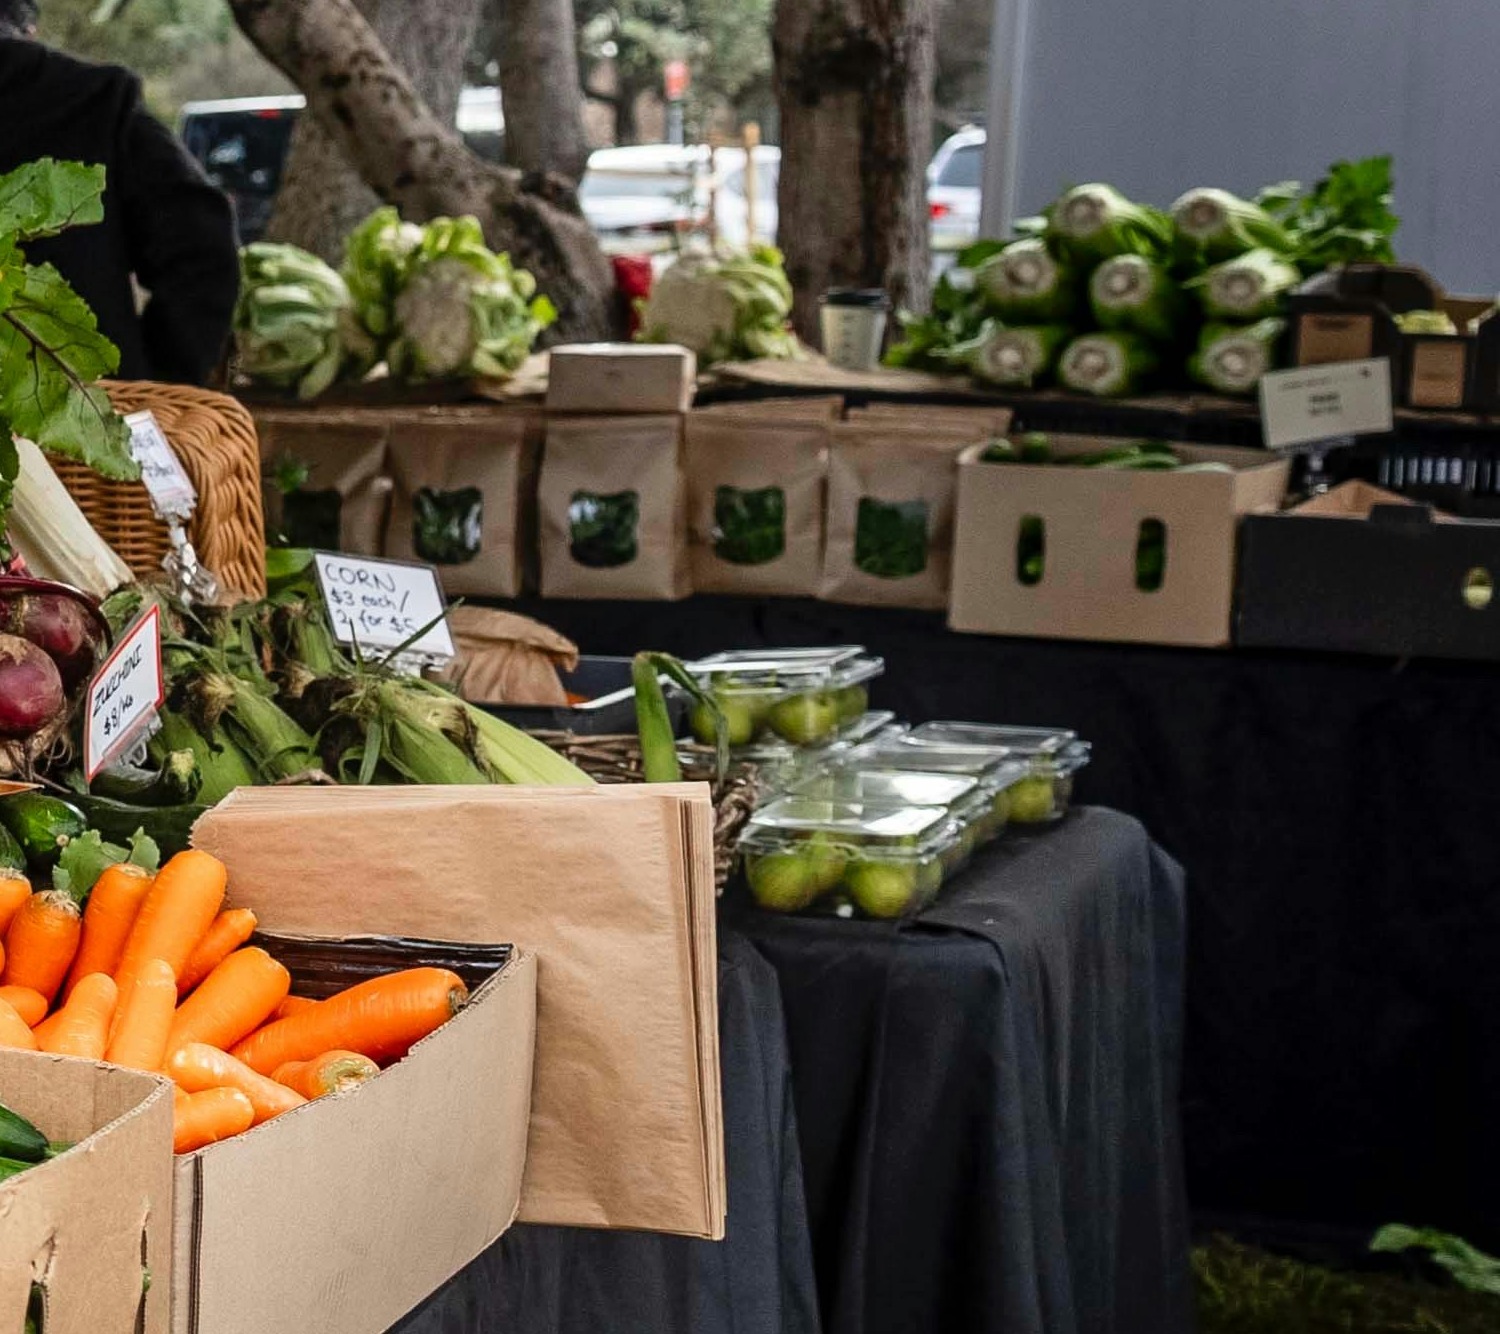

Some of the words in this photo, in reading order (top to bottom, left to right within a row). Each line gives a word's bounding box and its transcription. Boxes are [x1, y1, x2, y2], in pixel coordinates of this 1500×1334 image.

[324, 562, 397, 592] CORN
[331, 588, 355, 606] $3
[336, 609, 349, 624] 2
[359, 609, 383, 634] for
